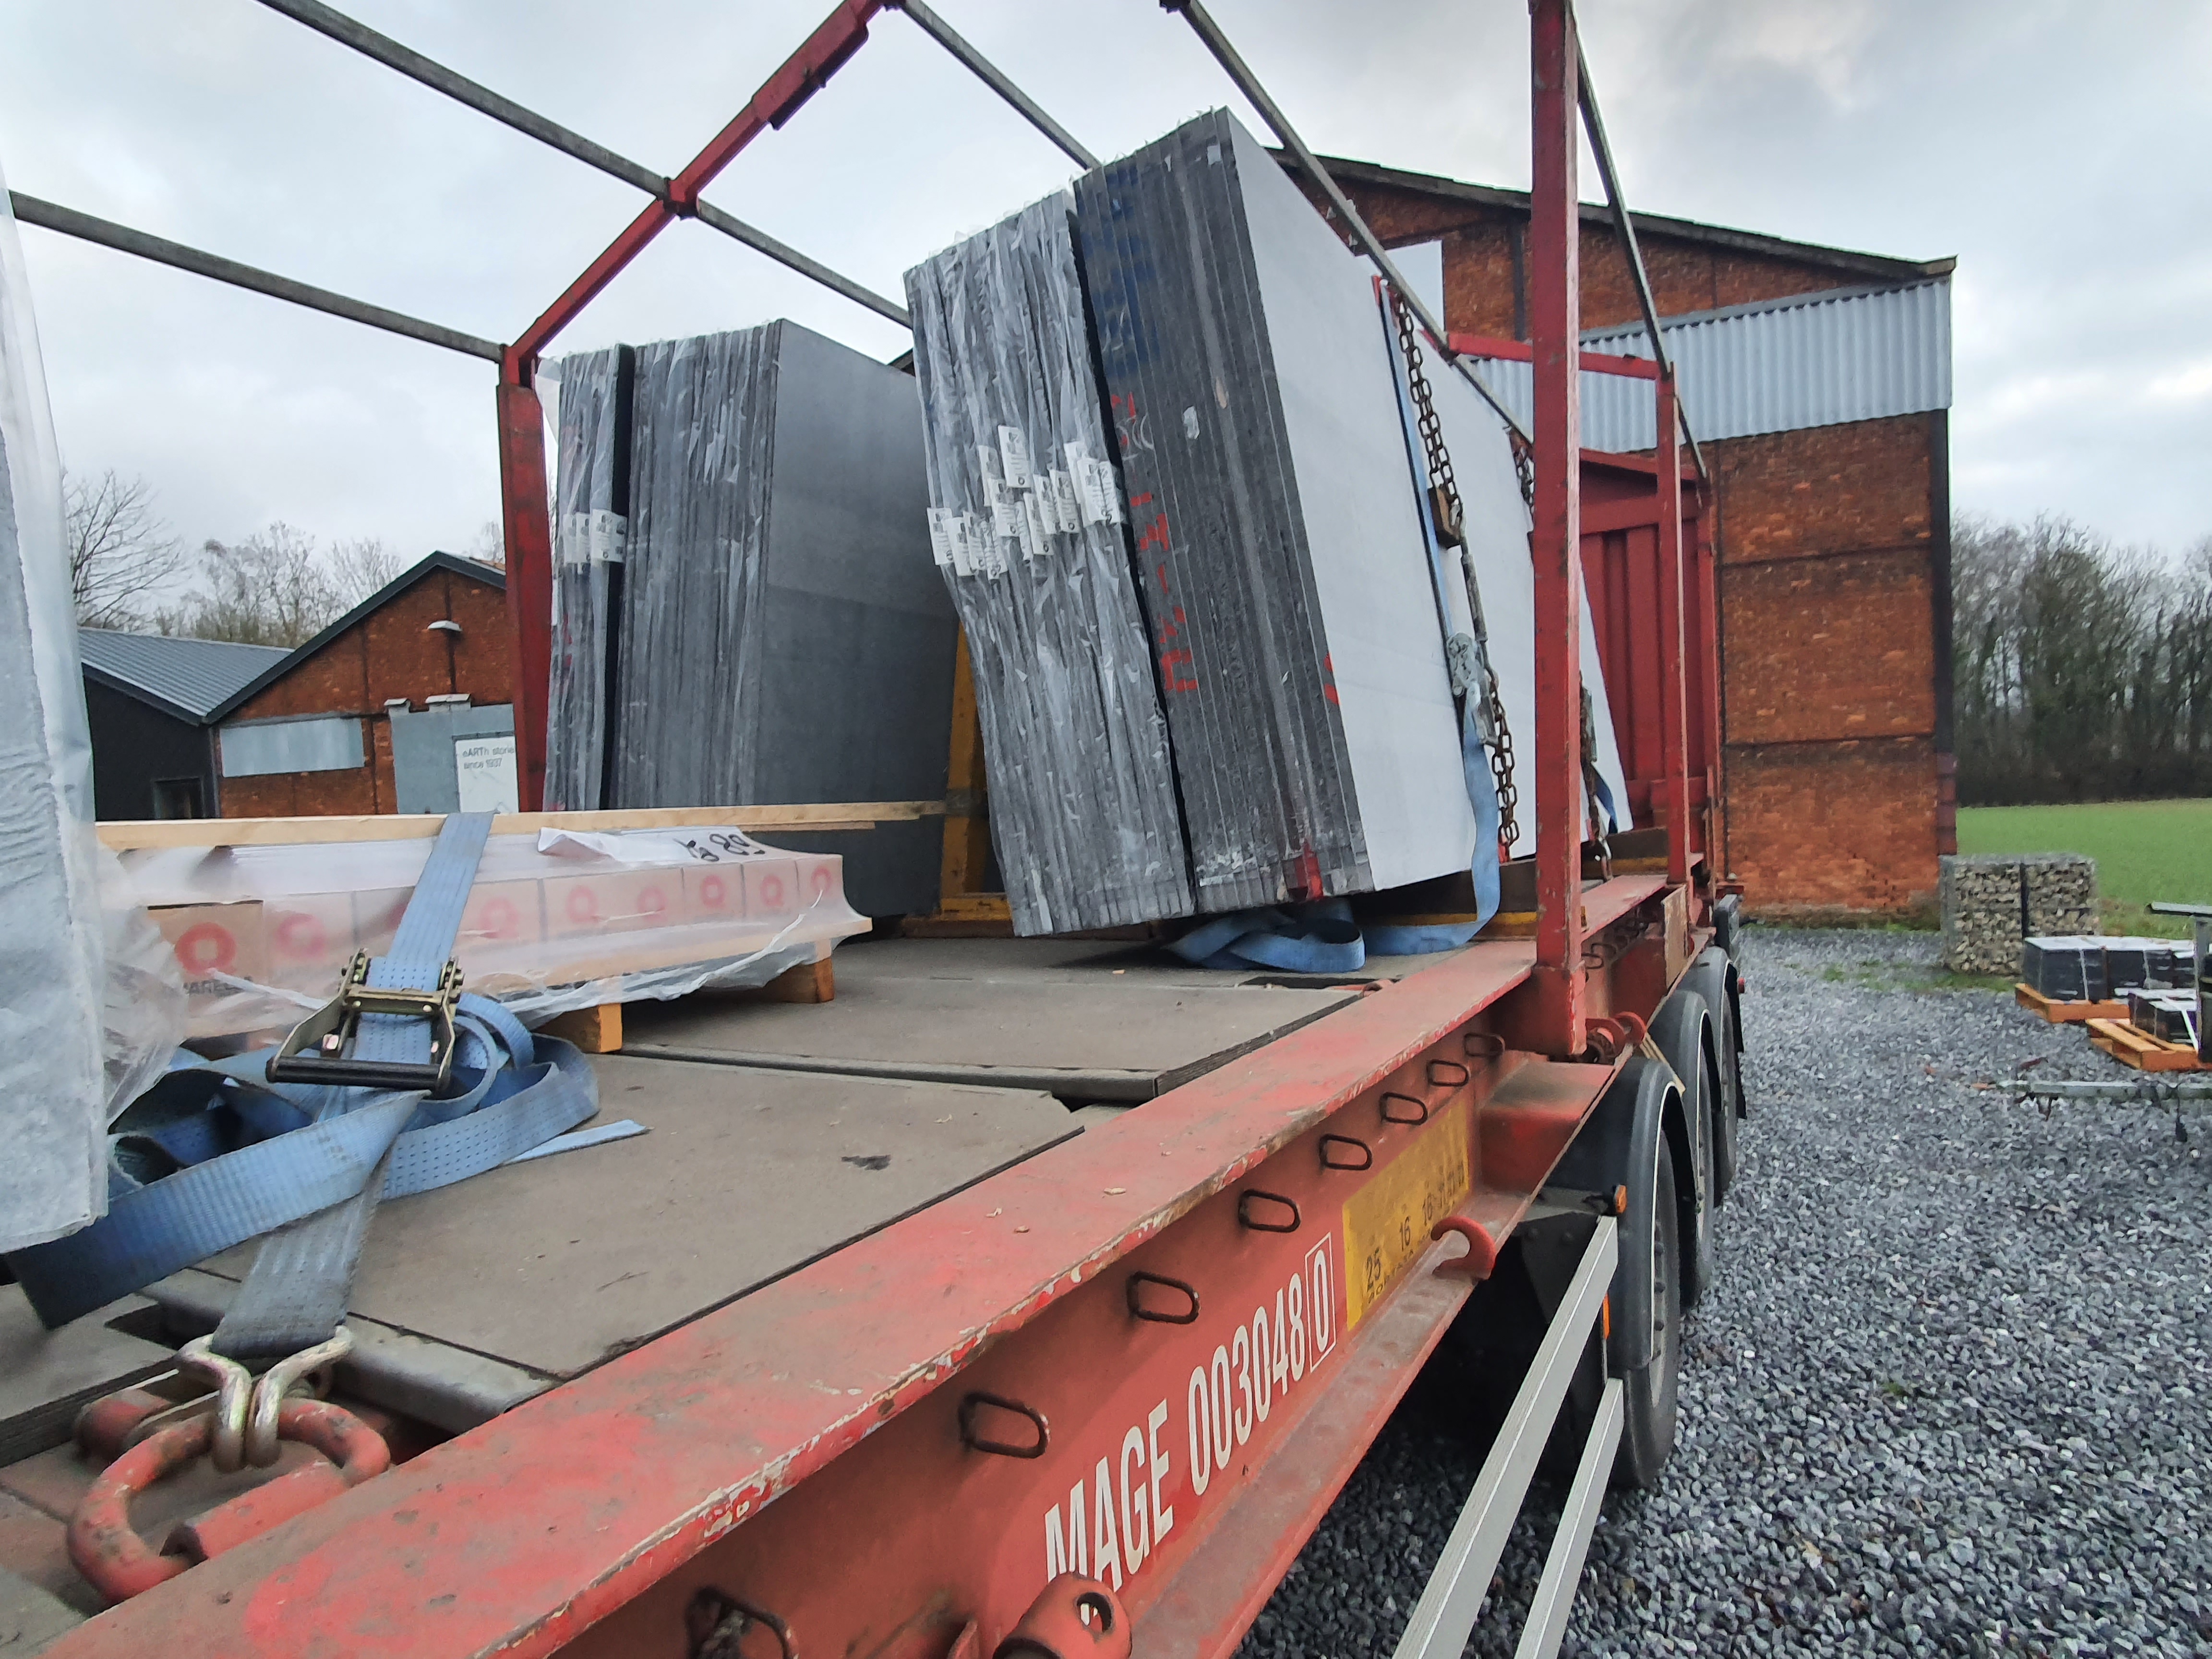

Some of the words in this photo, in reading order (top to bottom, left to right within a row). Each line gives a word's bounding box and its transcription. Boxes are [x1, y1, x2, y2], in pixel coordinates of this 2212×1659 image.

[1366, 1247, 1382, 1292] 25
[1399, 1215, 1412, 1252] 16
[1044, 1398, 1174, 1593] MAGE
[1187, 1272, 1306, 1496] 003048
